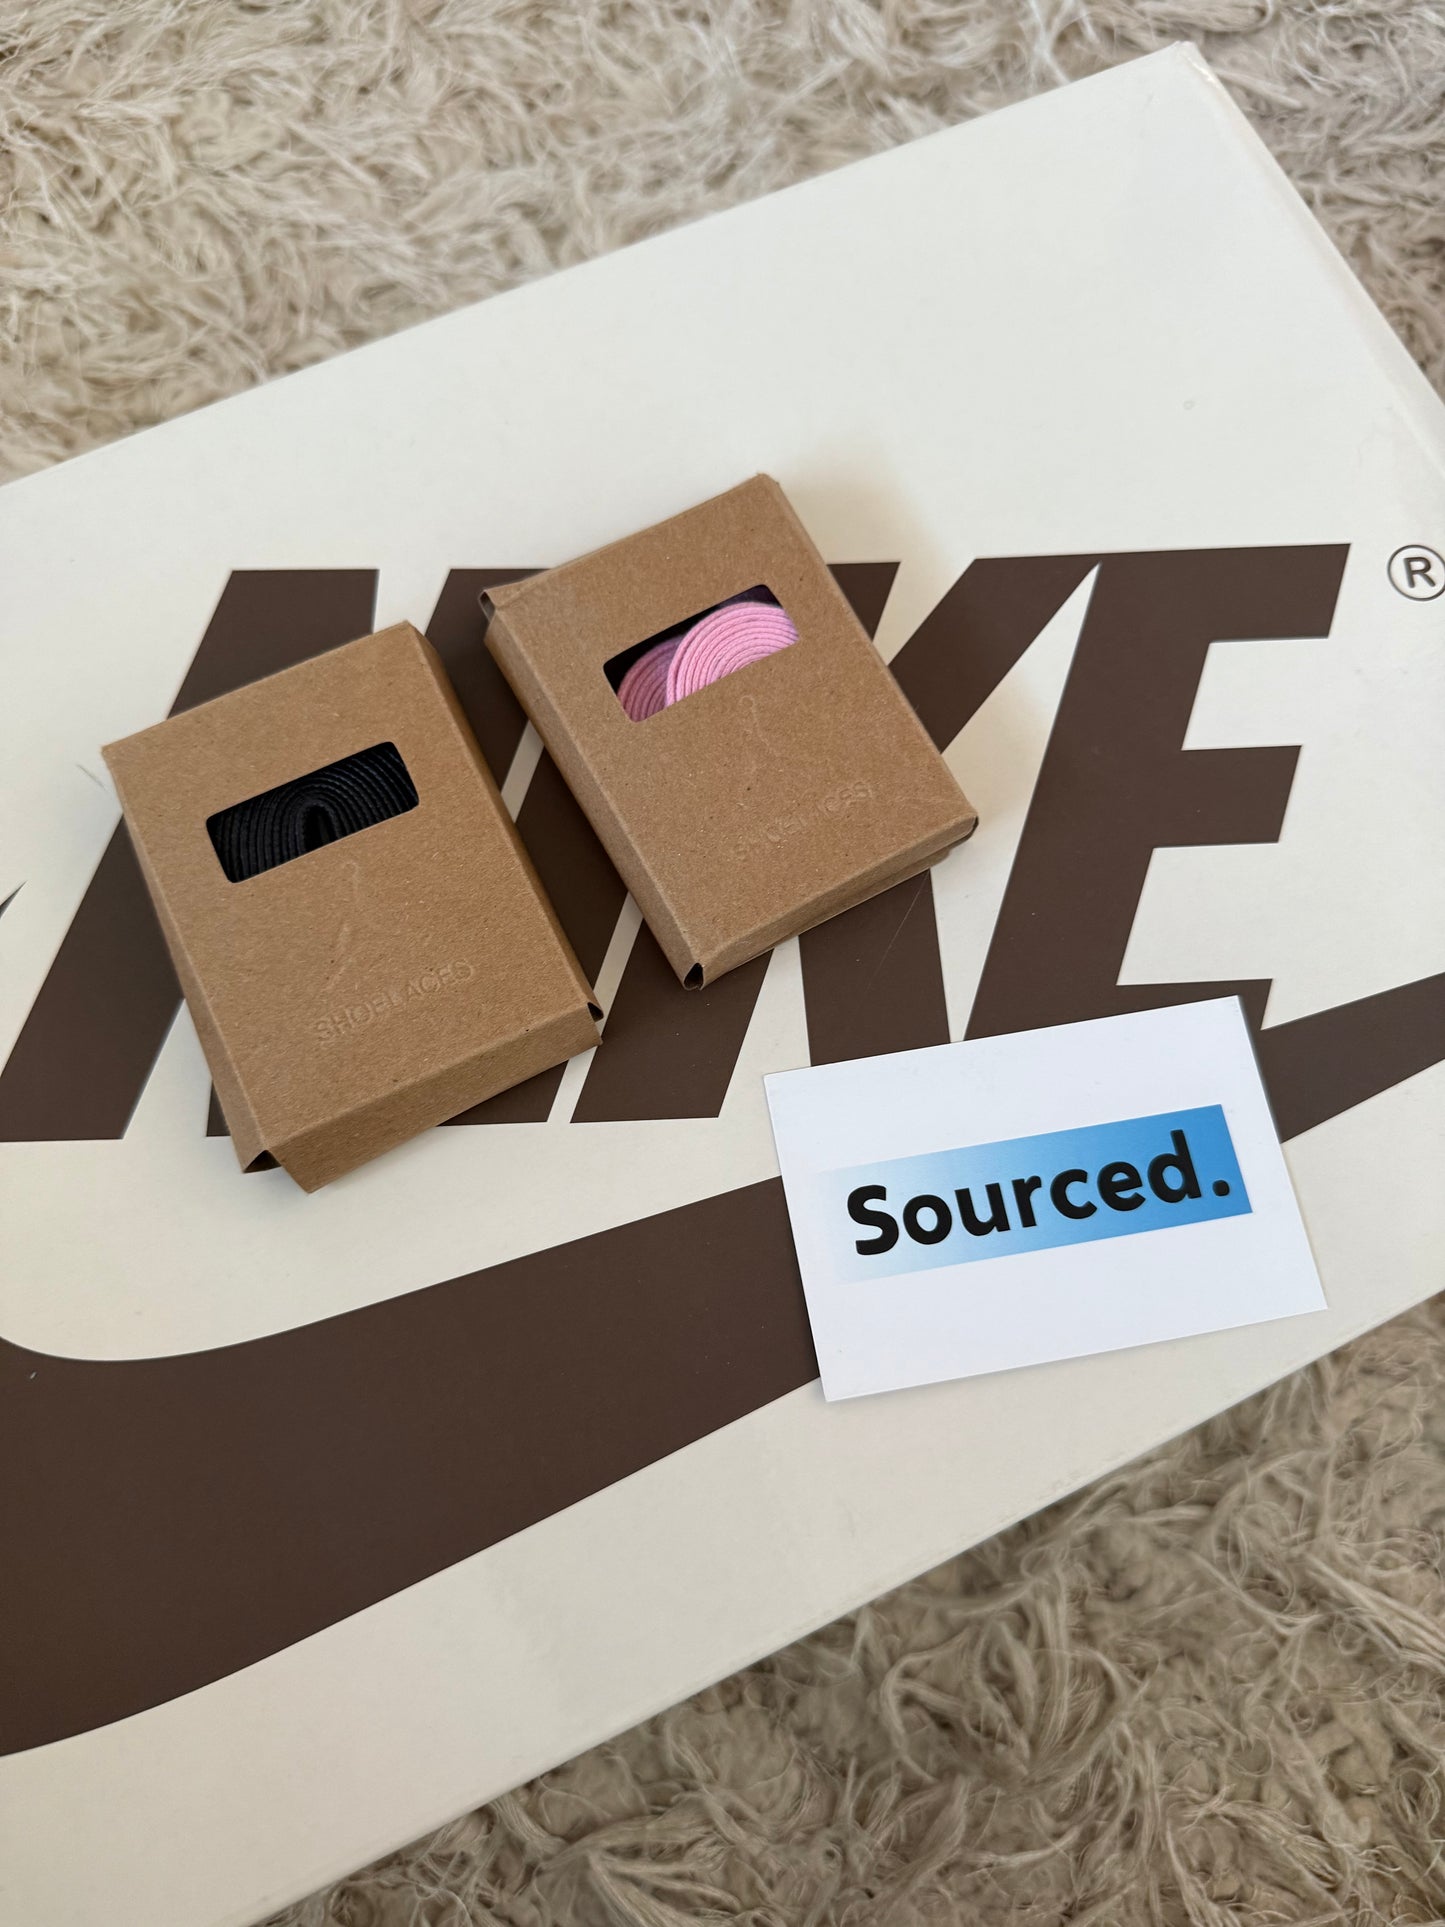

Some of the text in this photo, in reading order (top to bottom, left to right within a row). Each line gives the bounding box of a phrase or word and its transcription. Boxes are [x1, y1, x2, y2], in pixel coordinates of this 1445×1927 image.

[0, 541, 1350, 1141] KE
[312, 958, 477, 1044] SHOELACES
[846, 1129, 1230, 1256] Sourced.
